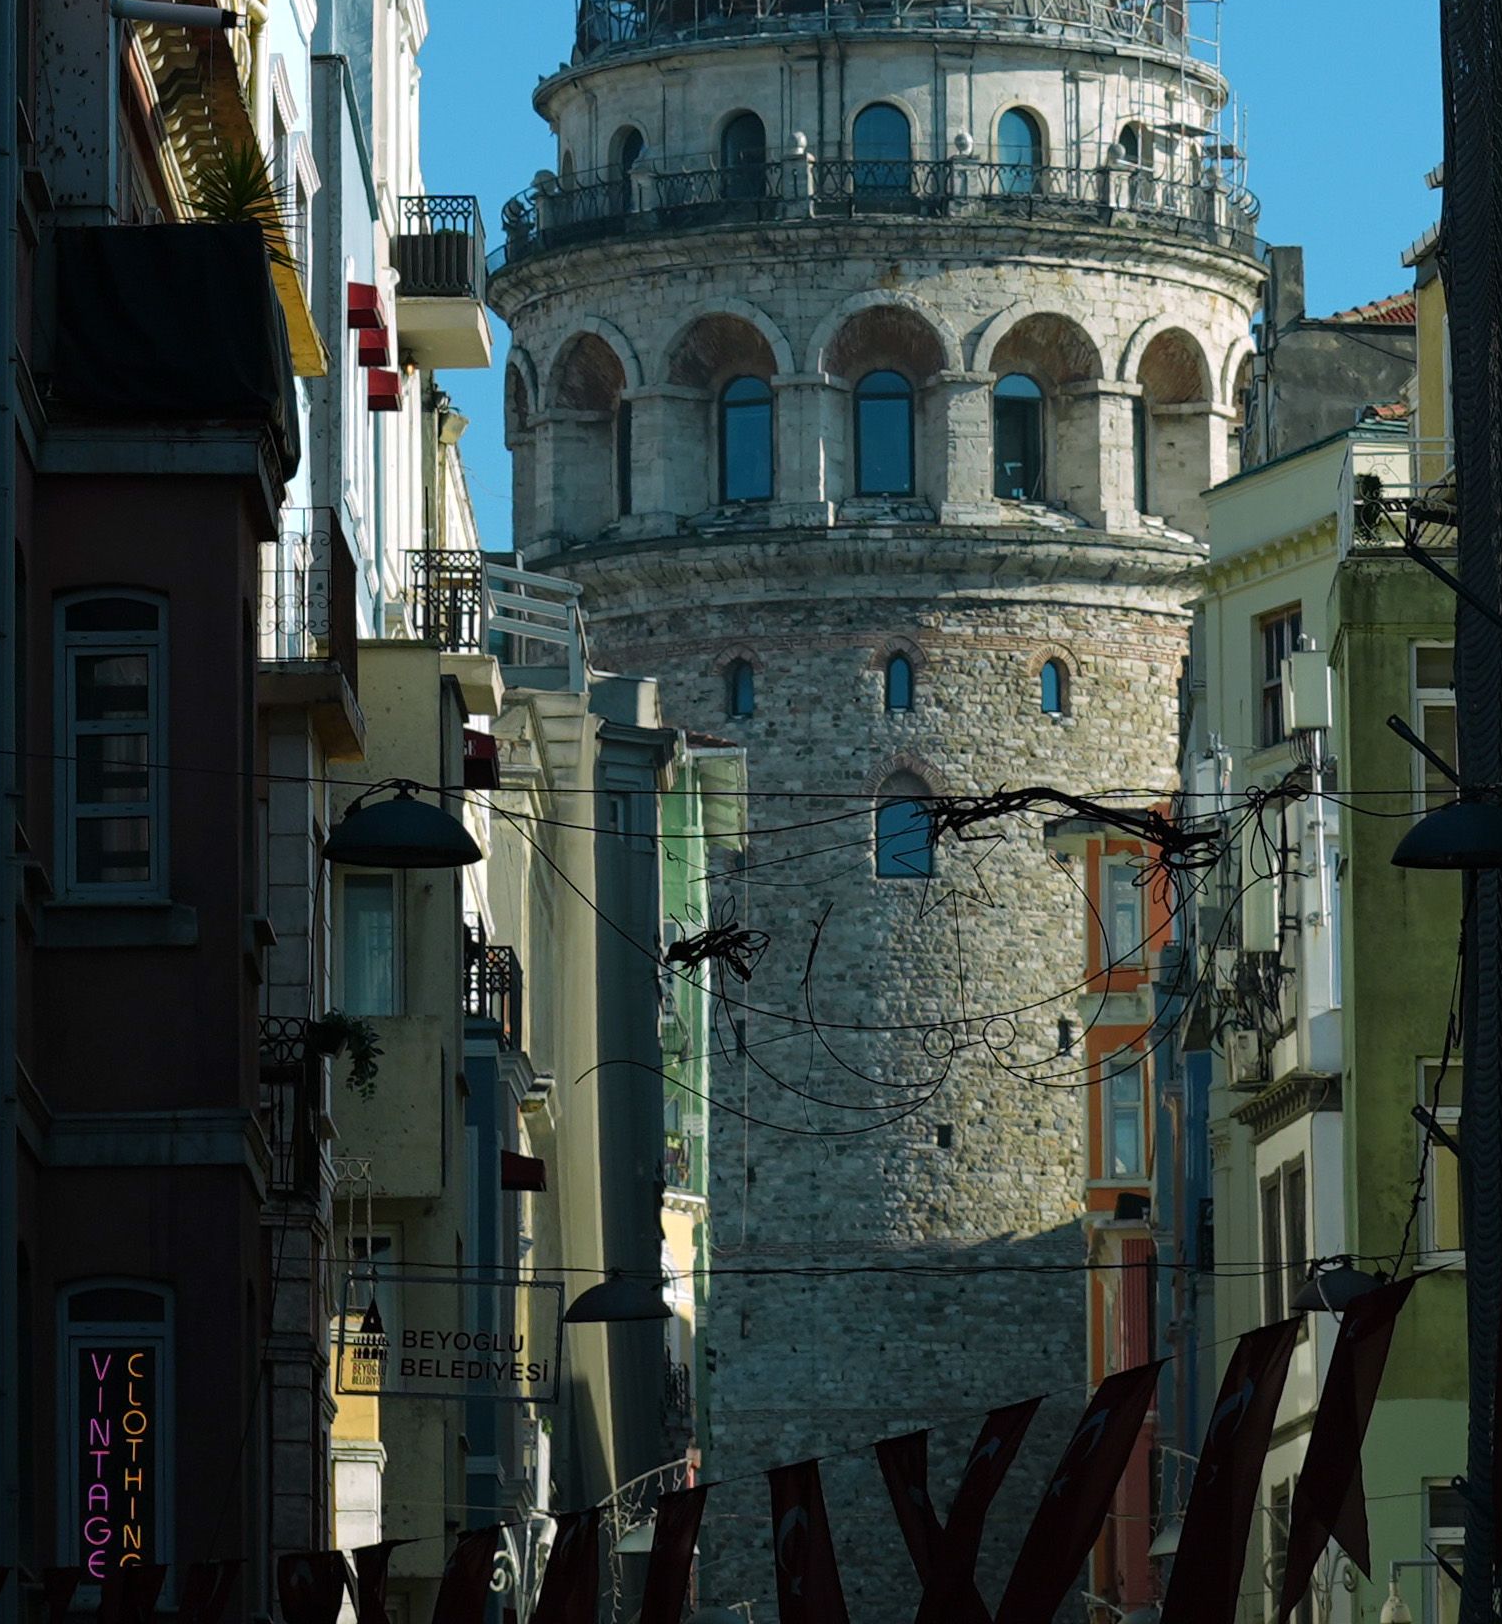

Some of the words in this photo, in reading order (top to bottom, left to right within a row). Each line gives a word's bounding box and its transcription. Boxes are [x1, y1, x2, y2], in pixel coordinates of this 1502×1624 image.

[402, 1329, 524, 1353] BEYOĞLU
[400, 1358, 548, 1383] BELEDİYESİ
[83, 1352, 112, 1579] VINTAGE
